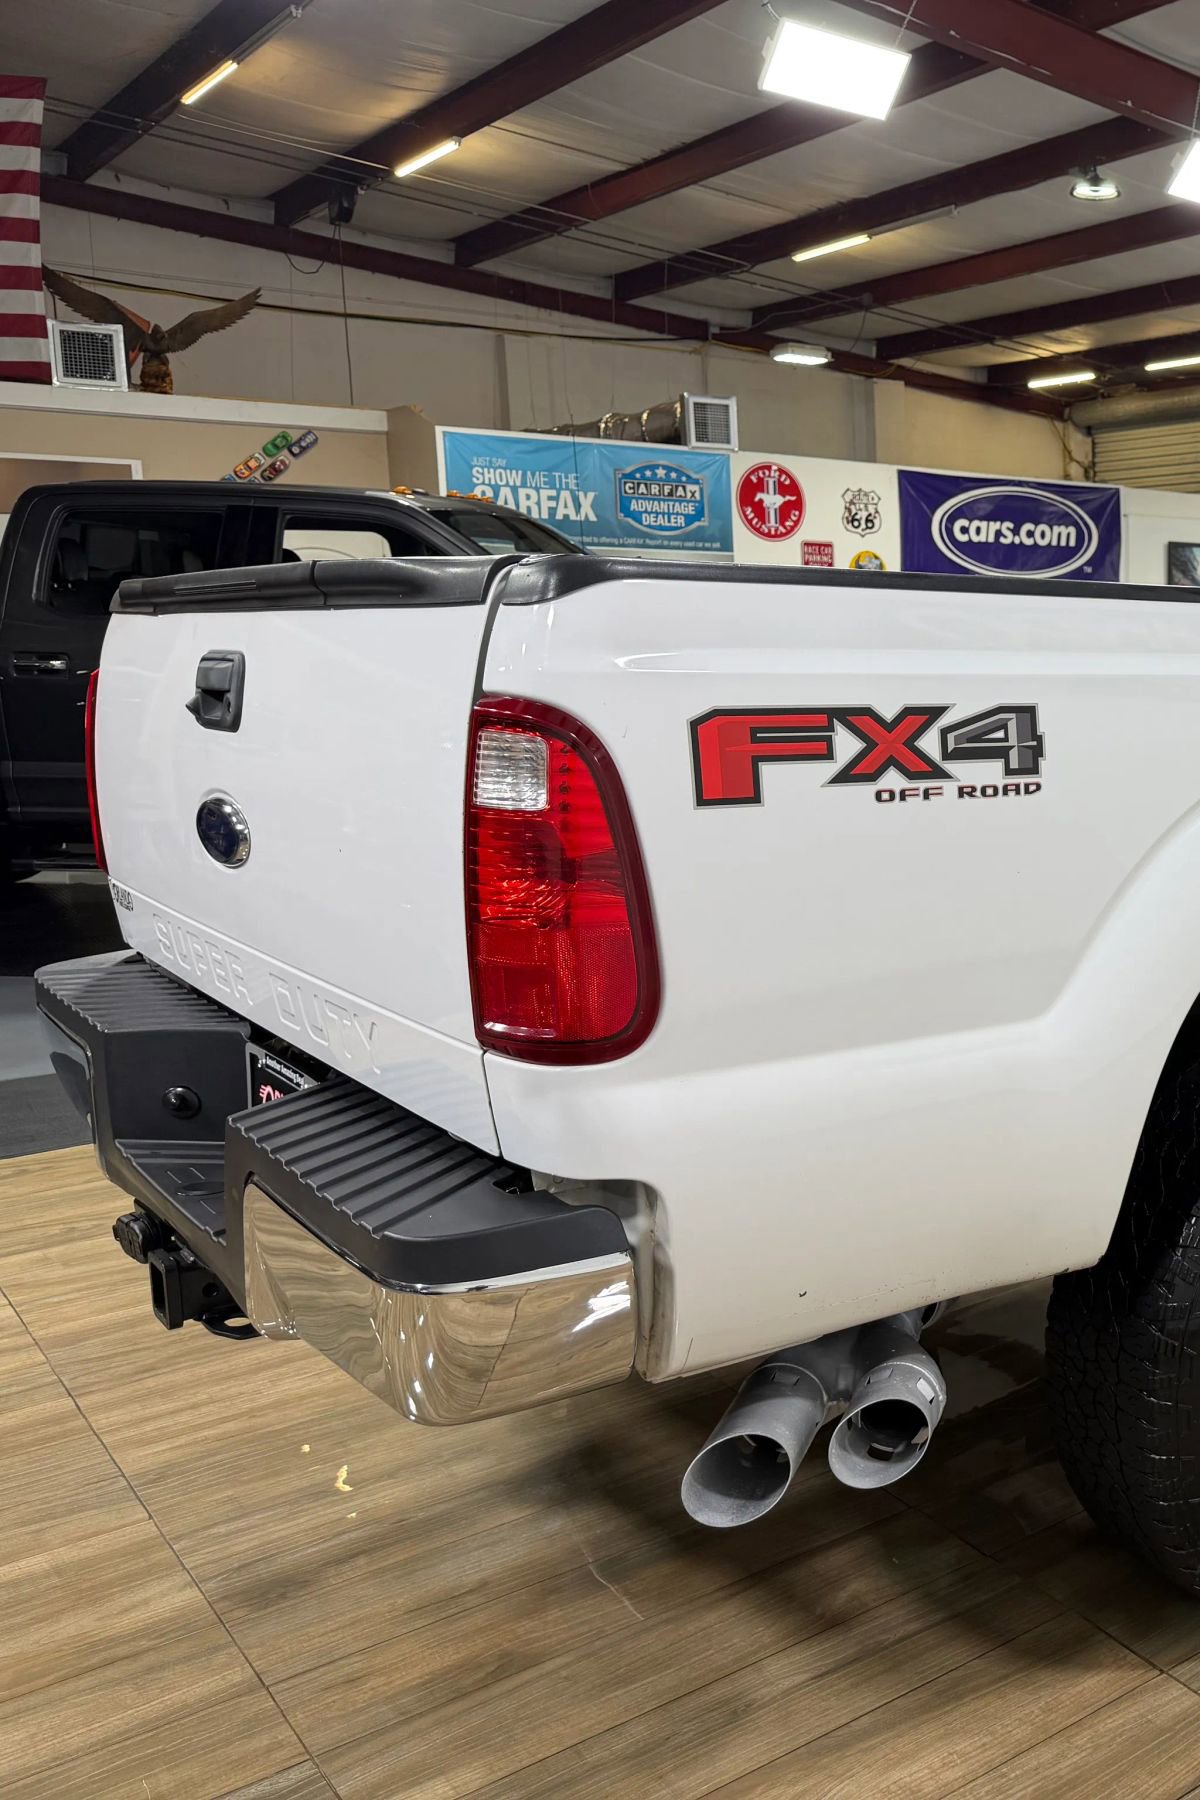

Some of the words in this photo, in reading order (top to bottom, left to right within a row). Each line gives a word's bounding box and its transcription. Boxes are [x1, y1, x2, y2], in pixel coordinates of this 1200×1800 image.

[472, 457, 489, 466] JUST
[492, 458, 507, 467] SAY
[472, 467, 522, 487] SHOW
[527, 471, 550, 488] ME
[552, 472, 580, 490] THE
[750, 469, 791, 485] FORD
[624, 482, 698, 500] CARFAX
[630, 499, 696, 514] ADVANTAGE
[642, 513, 686, 528] DEALER
[743, 506, 800, 535] MUSTANG
[851, 512, 875, 530] 66
[953, 518, 1077, 547] cars.com
[686, 702, 1046, 811] FX4
[874, 785, 945, 804] OFF
[957, 781, 1043, 800] ROAD
[152, 913, 253, 1006] SUPER
[269, 972, 381, 1075] DUTY
